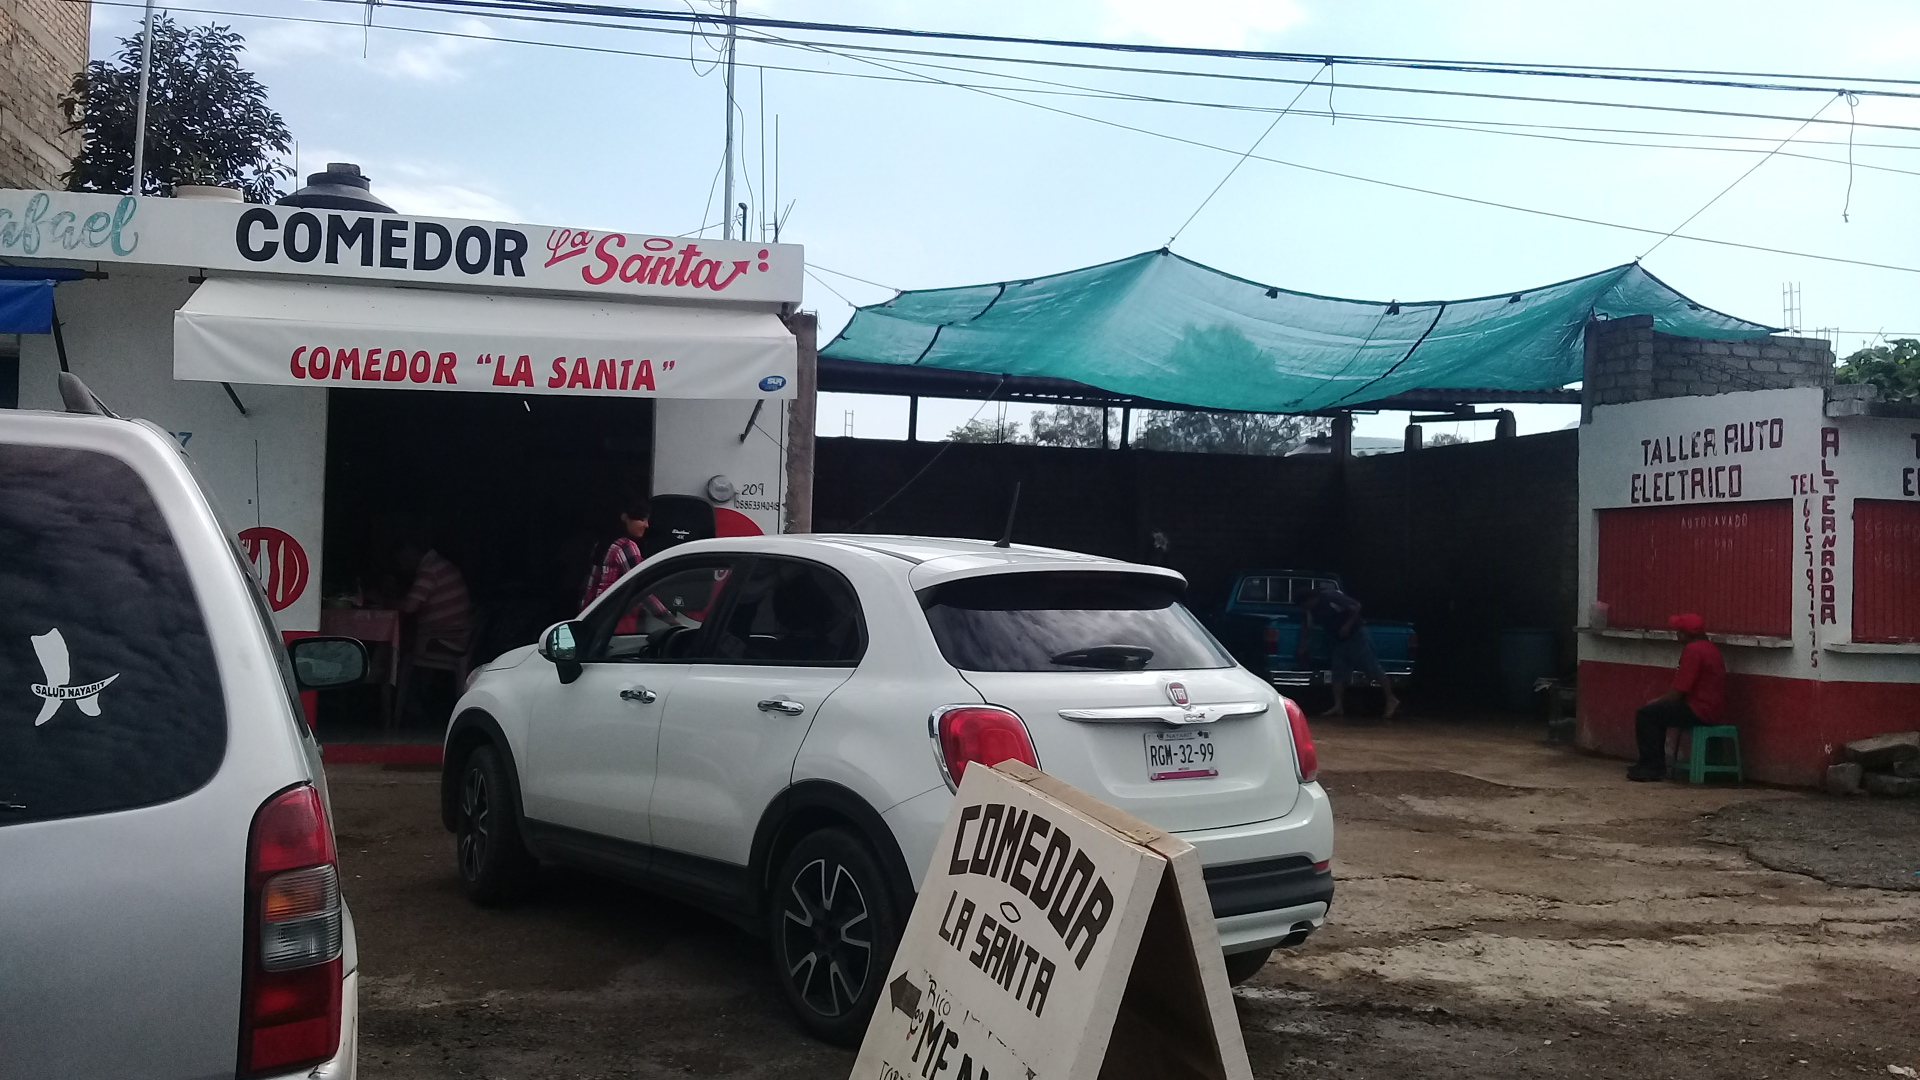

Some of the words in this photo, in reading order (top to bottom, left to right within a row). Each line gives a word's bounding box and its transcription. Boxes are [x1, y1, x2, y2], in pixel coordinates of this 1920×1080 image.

[236, 208, 528, 277] COMEDOR
[545, 229, 594, 268] La
[582, 233, 750, 291] Santa
[290, 345, 457, 384] COMEDOR
[1641, 428, 1717, 466] TALLER
[1724, 418, 1784, 455] AUTO
[741, 483, 764, 496] 209
[1631, 464, 1742, 503] ELECTRICO
[1790, 473, 1818, 496] TEL
[1820, 426, 1840, 625] ALTERNADOR
[35, 685, 65, 698] SALUD
[68, 681, 106, 698] NAYARIT
[1150, 743, 1214, 767] RGM-32-99
[949, 803, 1114, 971] COMEDOR
[938, 890, 976, 952] LA
[969, 913, 1056, 1018] SANTA
